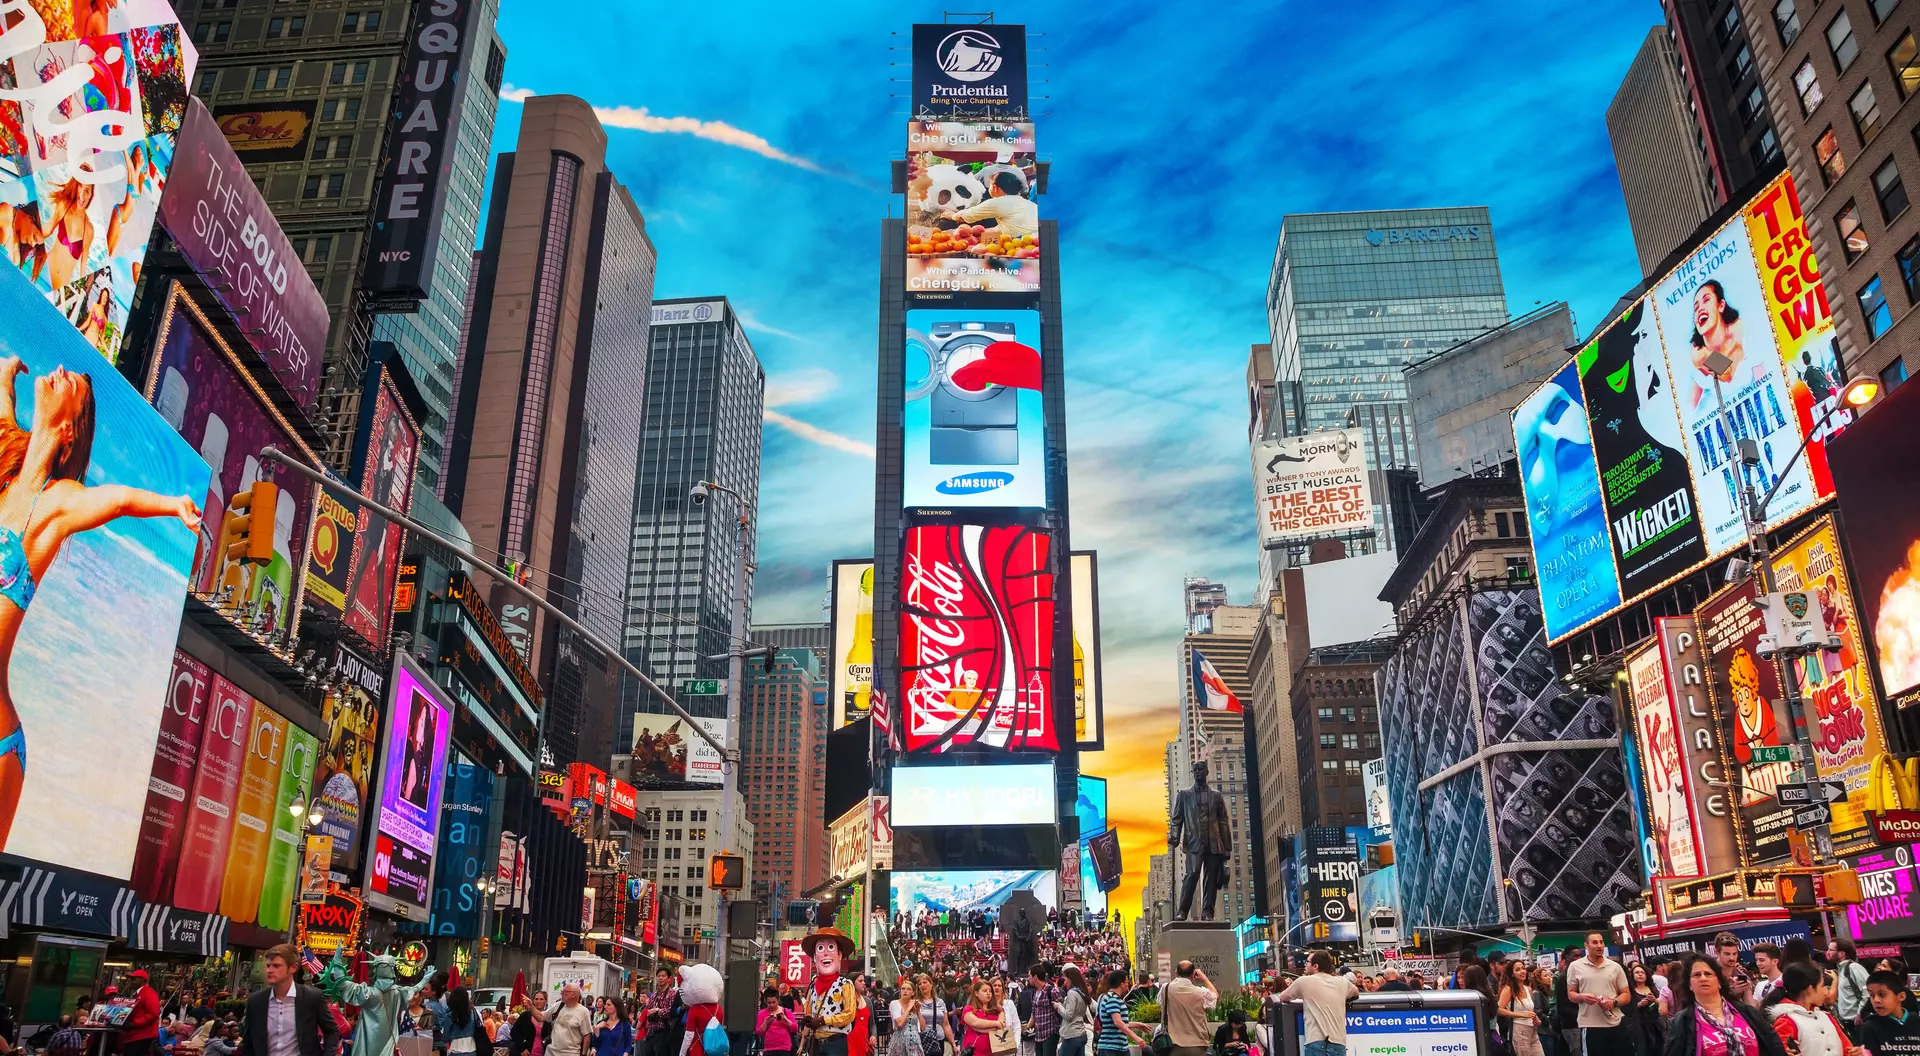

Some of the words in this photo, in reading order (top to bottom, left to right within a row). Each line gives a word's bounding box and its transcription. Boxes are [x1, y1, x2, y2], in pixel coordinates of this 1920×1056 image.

[932, 84, 1008, 96] Prudential
[994, 124, 1016, 132] Live.
[910, 133, 981, 145] Chengdu,
[208, 153, 243, 230] THE
[241, 214, 287, 295] BOLD
[1389, 225, 1480, 244] BARCLAYS
[379, 250, 411, 262] NYC
[1675, 262, 1696, 284] THE
[1697, 238, 1719, 264] FUN
[960, 267, 996, 276] Pandas
[999, 267, 1022, 275] Live.
[1666, 277, 1697, 308] NEVER
[1699, 240, 1737, 282] STOPS!
[193, 200, 237, 278] SIDE
[238, 262, 262, 304] OF
[262, 292, 309, 380] WATER
[910, 277, 985, 291] Chengdu,
[650, 308, 689, 321] llianz
[946, 478, 1005, 488] SAMSUNG
[1266, 474, 1297, 484] WINNER
[1305, 470, 1327, 478] TONY
[1327, 466, 1360, 475] AWARDS
[1267, 483, 1298, 494] BEST
[1303, 474, 1362, 489] MUSICAL
[1607, 465, 1637, 491] BIGGEST
[1311, 485, 1362, 506] BEST
[1785, 481, 1802, 496] ABBA
[1269, 503, 1339, 521] MUSICAL
[1342, 499, 1365, 511] OF
[1270, 520, 1300, 532] THIS
[313, 514, 338, 575] Q
[1561, 532, 1577, 547] The
[1543, 531, 1604, 582] PHANTOM
[1808, 542, 1825, 562] Jessie
[1565, 569, 1573, 584] of
[1574, 564, 1586, 579] the
[1806, 553, 1835, 580] MUELLER
[1556, 575, 1599, 609] OPERA
[1724, 597, 1747, 618] ULTIMATE
[1707, 616, 1734, 638] FEEL-GOOD
[1723, 623, 1737, 638] BACK
[1738, 617, 1750, 630] AND
[1713, 640, 1729, 654] BETTER
[1729, 632, 1744, 647] THAN
[175, 651, 208, 677] SPARKLING
[336, 651, 342, 671] A
[343, 656, 361, 682] JOY
[1638, 662, 1658, 689] CAUSE
[164, 664, 205, 724] ICE
[686, 683, 692, 693] W
[695, 682, 705, 694] 46
[1812, 678, 1852, 719] NICE
[211, 692, 246, 747] ICE
[704, 722, 713, 731] By
[1677, 633, 1726, 816] PALACE
[171, 733, 196, 753] Raspberry
[251, 716, 281, 766] ICE
[205, 751, 215, 761] Pink
[286, 738, 312, 784] ICE
[696, 748, 708, 756] did
[710, 749, 718, 757] it.
[1754, 751, 1762, 761] W
[1765, 750, 1777, 761] 46
[1826, 755, 1837, 768] You
[1837, 751, 1848, 765] Can
[149, 780, 161, 790] ZERO
[162, 785, 184, 799] CALORIES
[1784, 790, 1804, 799] ONE
[320, 793, 358, 818] MOTOWN
[442, 803, 461, 811] organ
[462, 803, 483, 815] Stanley
[1753, 809, 1794, 826] TICKETMASTER.COM
[1800, 813, 1810, 823] ONE
[1815, 810, 1825, 820] WAY
[1318, 861, 1359, 881] HERO
[1321, 888, 1340, 898] JUNE
[1341, 888, 1347, 896] 6
[1859, 872, 1896, 898] IMES
[78, 893, 99, 906] WE'RE
[76, 906, 94, 917] OPEN
[1857, 894, 1913, 925] SQUARE
[183, 919, 201, 931] WE'RE
[181, 932, 196, 942] OPEN
[1759, 933, 1805, 948] EXCHANGE
[1645, 946, 1655, 956] BOX
[1656, 944, 1674, 955] OFFICE
[1675, 941, 1690, 952] HERE
[1366, 1016, 1402, 1026] Green
[1406, 1016, 1427, 1025] and
[1430, 1014, 1467, 1024] Clean!
[1370, 1045, 1406, 1054] recycle
[1432, 1044, 1468, 1053] recycle
